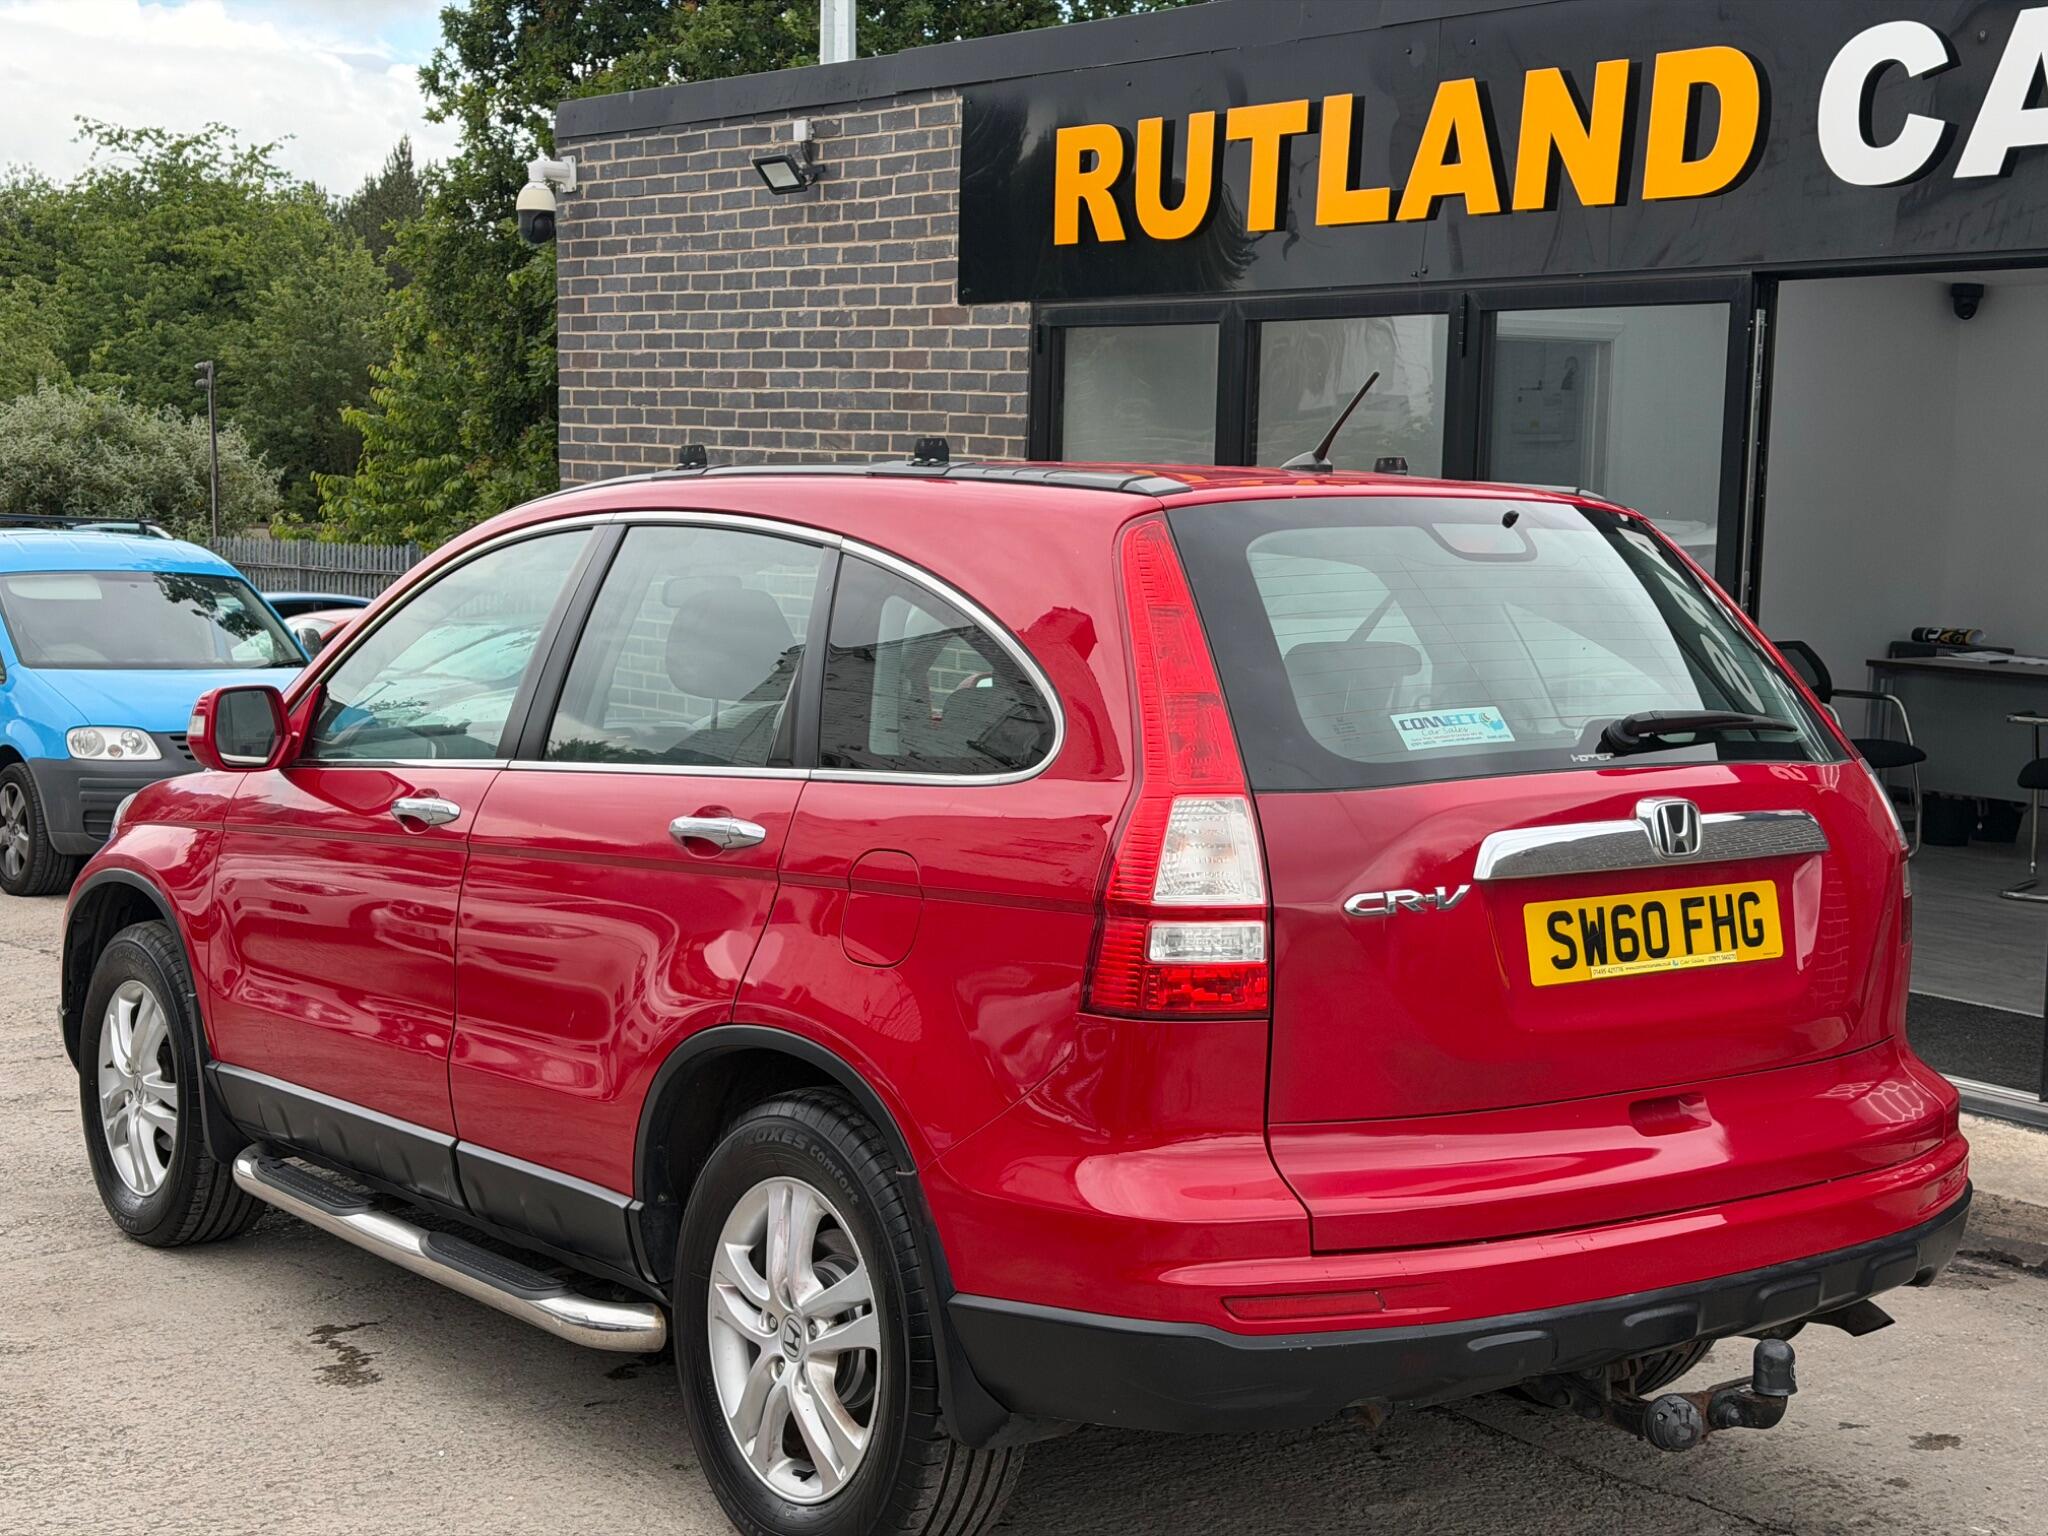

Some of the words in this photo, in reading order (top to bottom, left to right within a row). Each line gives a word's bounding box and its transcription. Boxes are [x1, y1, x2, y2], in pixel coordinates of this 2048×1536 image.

[1054, 45, 1760, 245] RUTLAND
[1399, 712, 1479, 731] CONNECT
[1343, 884, 1472, 916] CR-V
[1546, 901, 1670, 970] SW60
[1680, 891, 1765, 955] FHG
[809, 1144, 859, 1205] comfort
